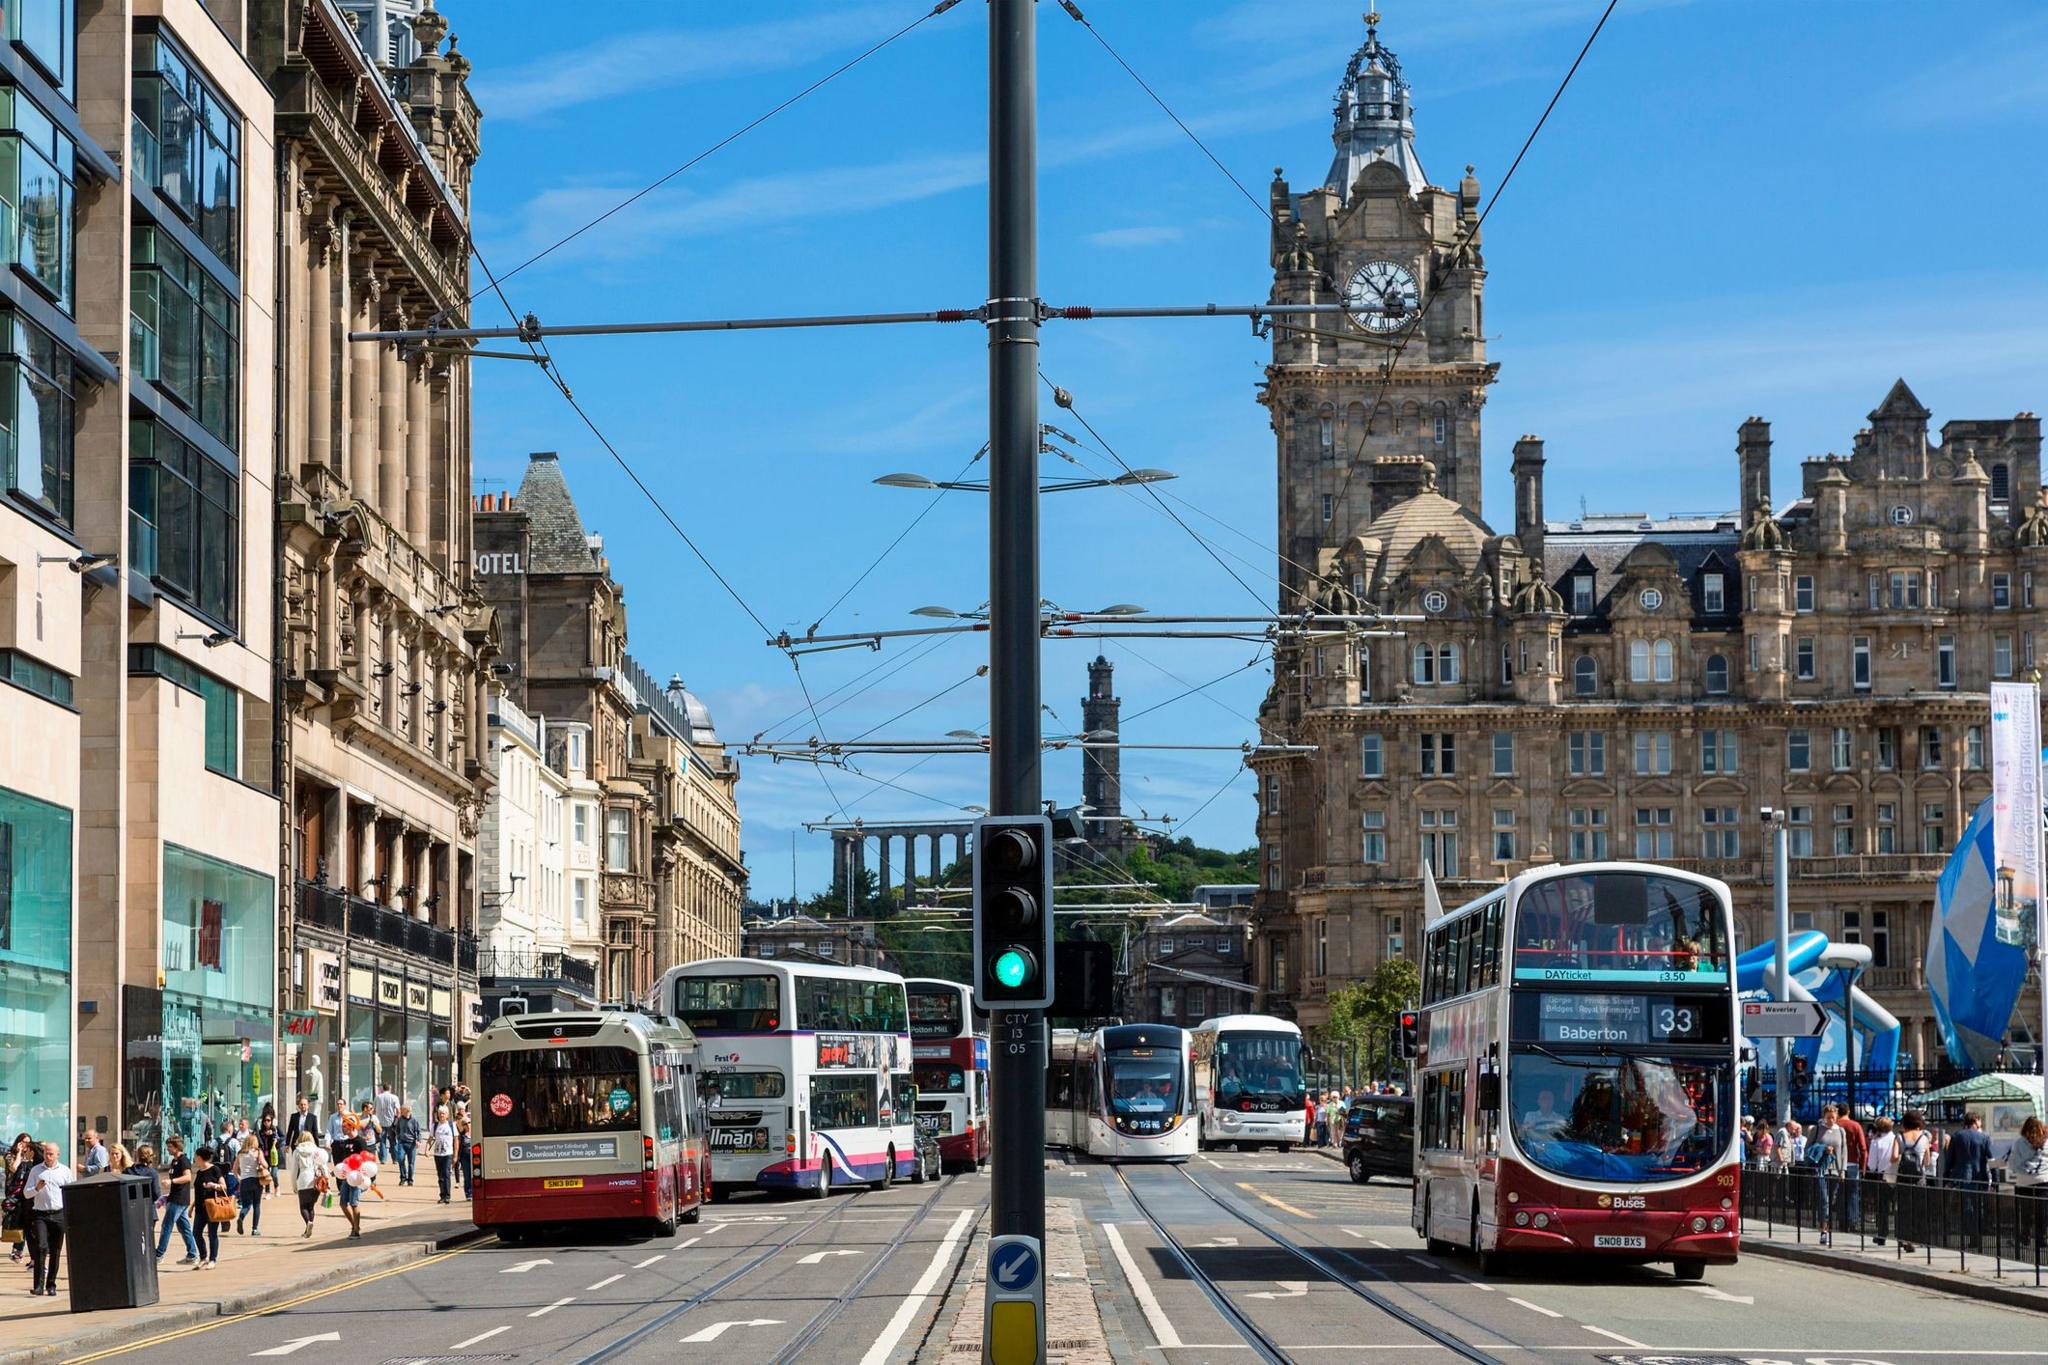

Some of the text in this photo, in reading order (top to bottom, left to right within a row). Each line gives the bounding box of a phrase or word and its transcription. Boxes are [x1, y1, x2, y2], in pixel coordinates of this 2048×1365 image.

[1765, 1006, 1797, 1014] Waverley
[1005, 1014, 1028, 1024] CTY
[1660, 1008, 1692, 1033] 33
[1560, 1026, 1627, 1040] Baberton
[526, 1150, 557, 1159] Download
[556, 1150, 573, 1158] your
[584, 1149, 597, 1157] app
[1717, 1175, 1734, 1187] 903
[1613, 1198, 1646, 1209] Buses
[1598, 1237, 1642, 1247] SN08 BXS
